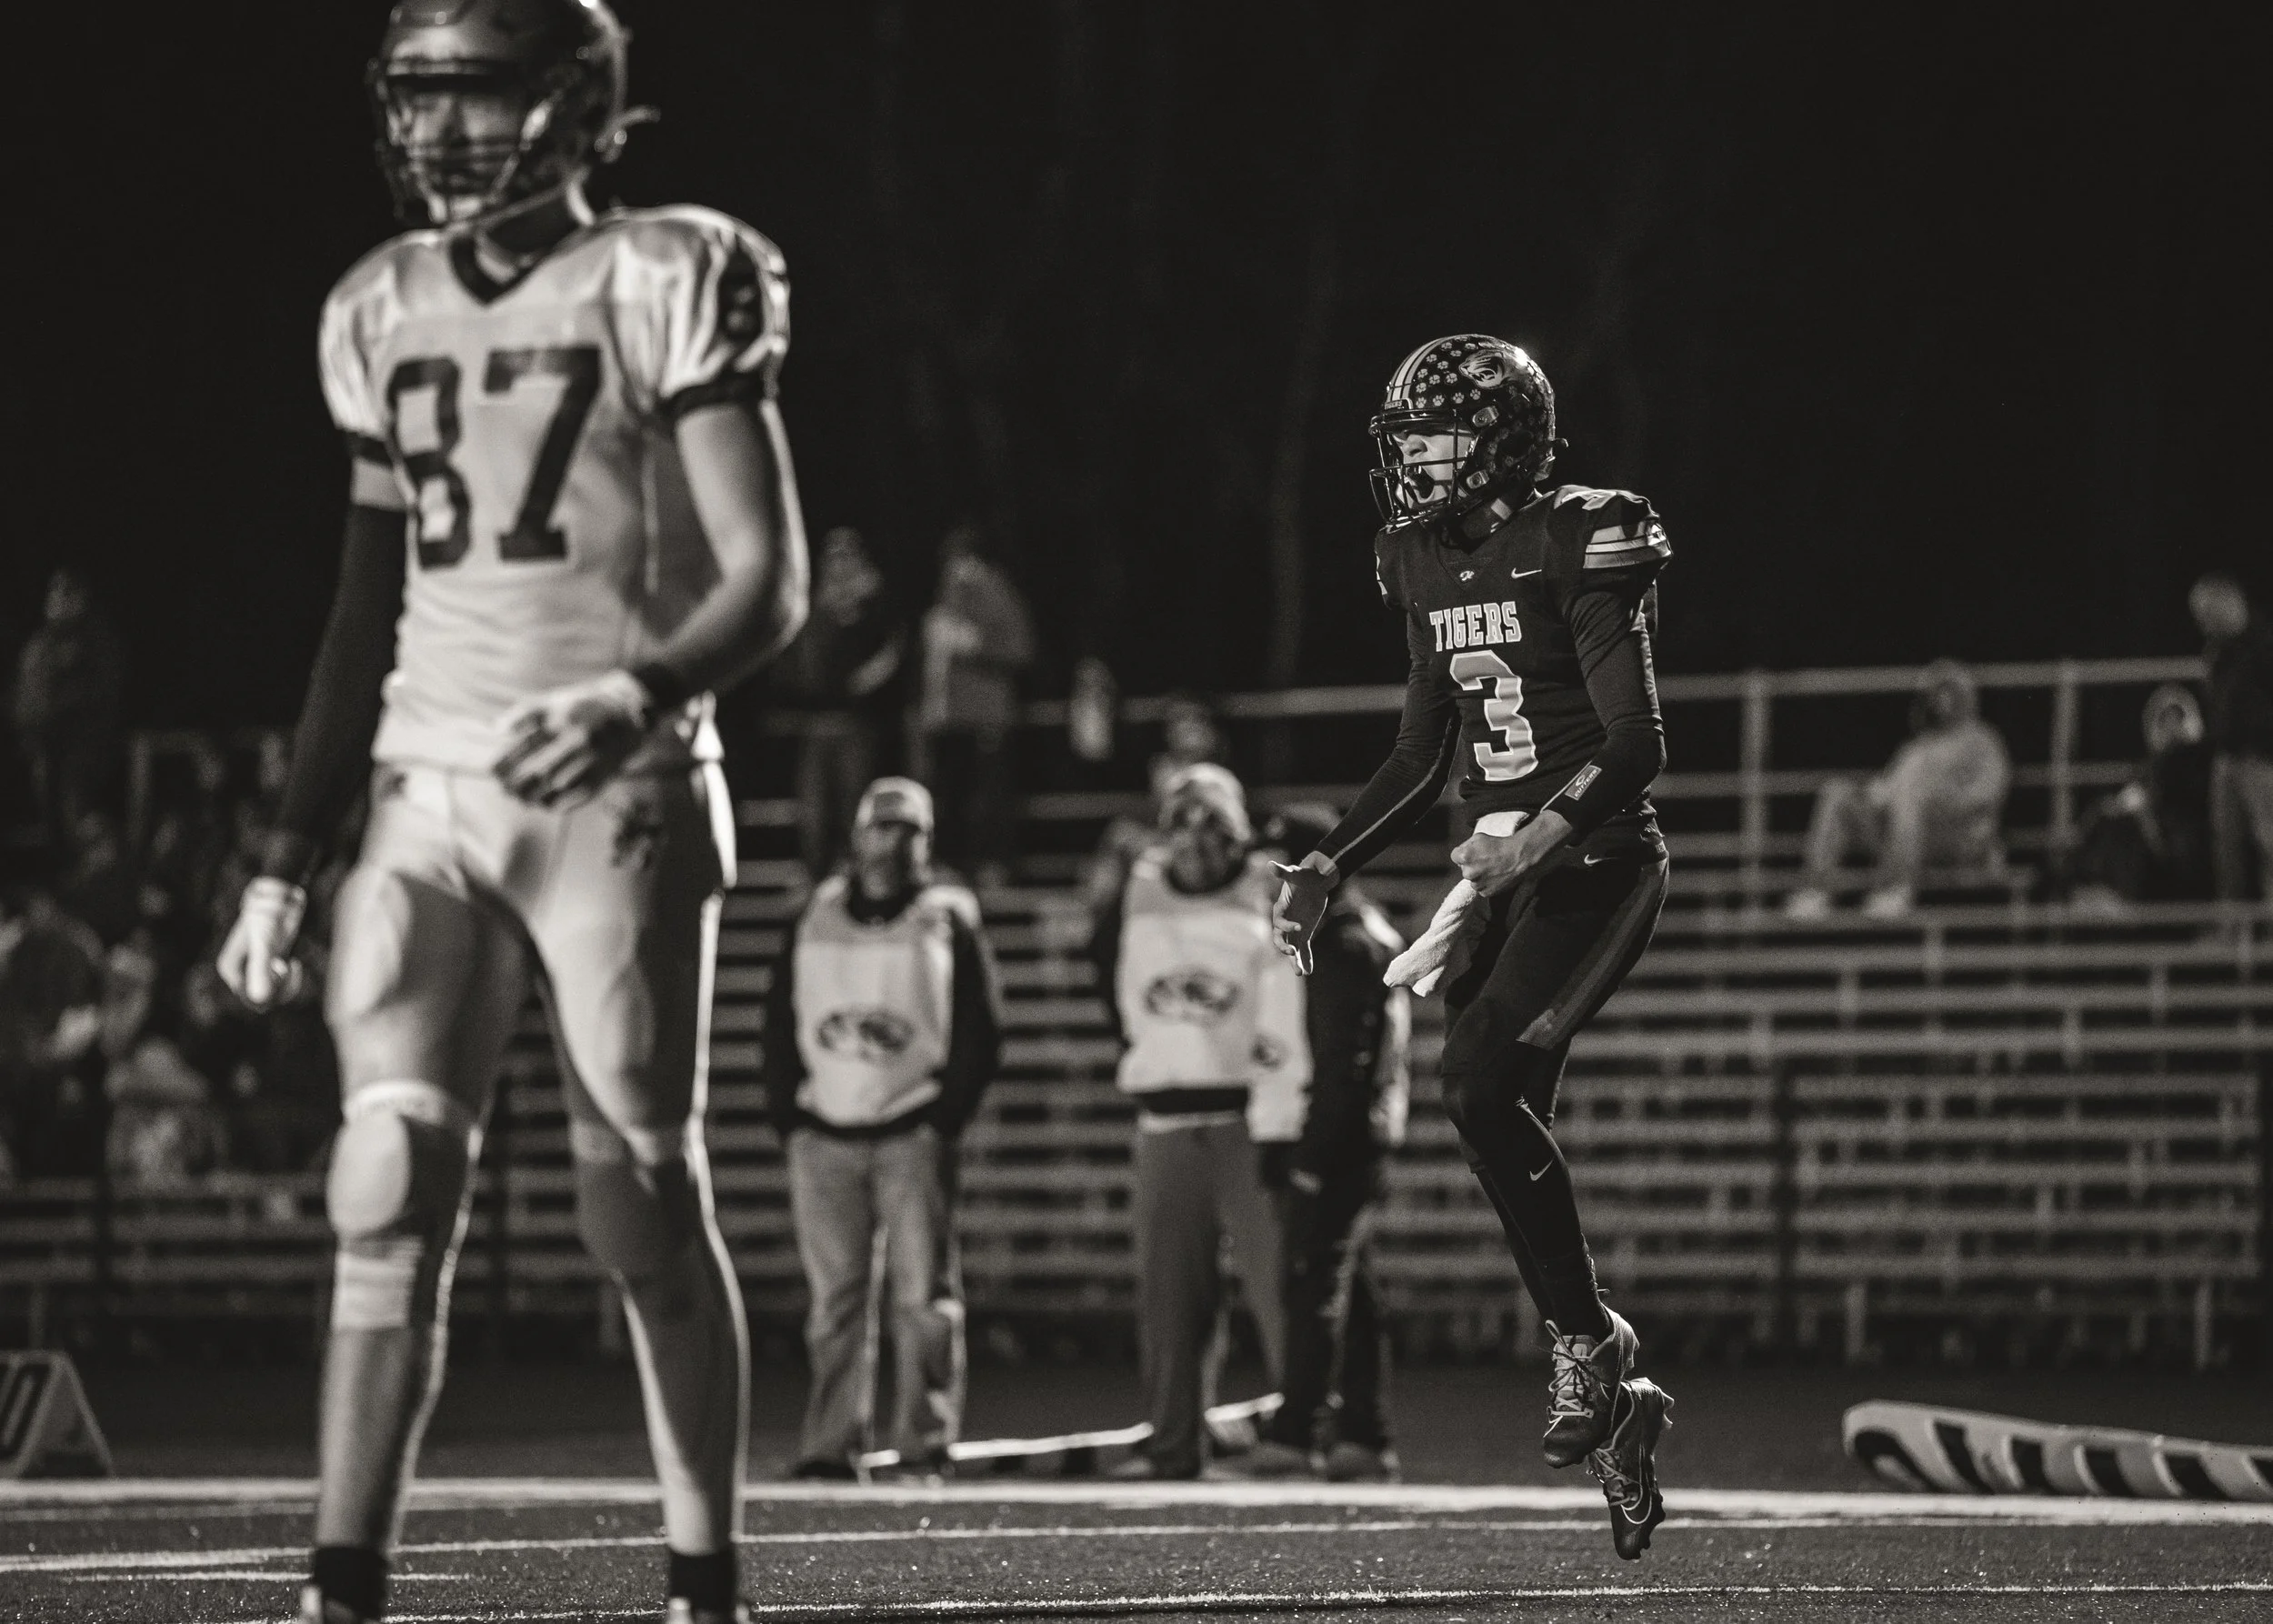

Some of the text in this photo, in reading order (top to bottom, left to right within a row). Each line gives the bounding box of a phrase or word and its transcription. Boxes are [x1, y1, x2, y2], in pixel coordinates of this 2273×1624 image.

[386, 344, 601, 570] 87
[1428, 601, 1522, 652] TIGERS
[1449, 649, 1538, 781] 3
[0, 1362, 50, 1457] 0
